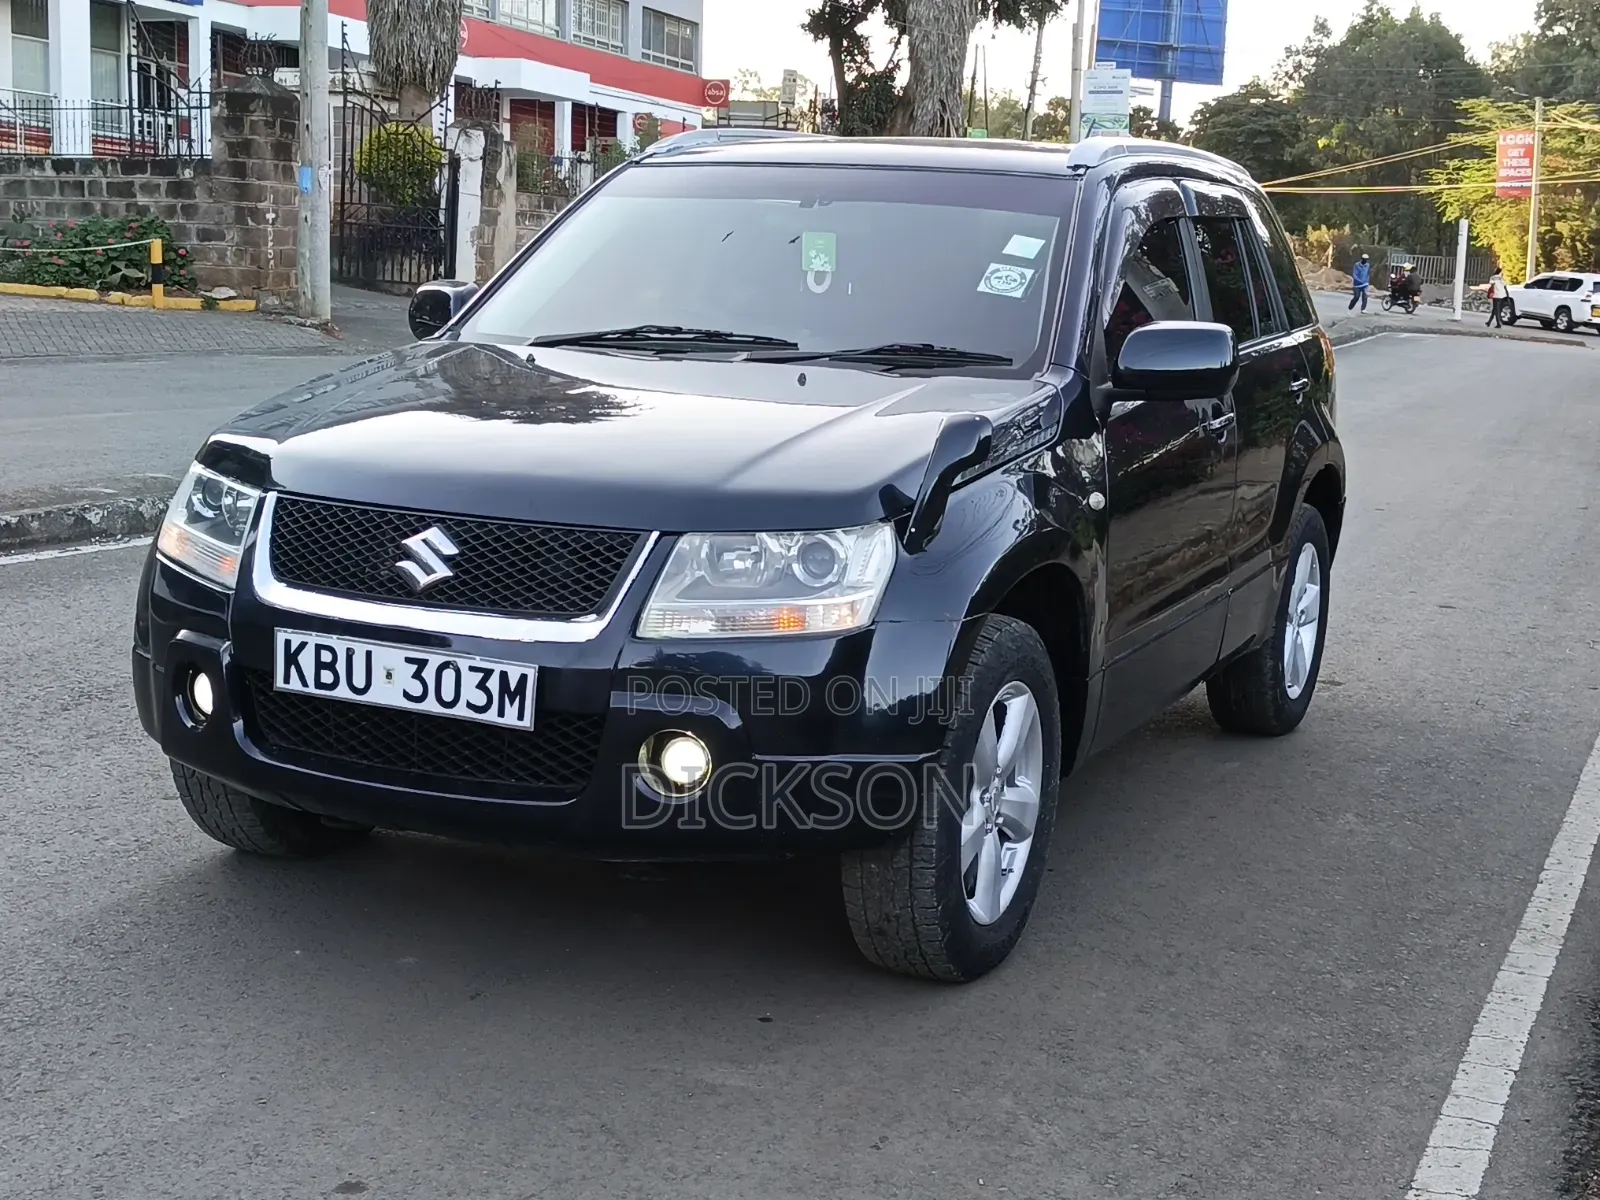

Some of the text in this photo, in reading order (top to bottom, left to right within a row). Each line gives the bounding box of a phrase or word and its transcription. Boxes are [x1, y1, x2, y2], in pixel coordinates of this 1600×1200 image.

[1499, 133, 1534, 145] LOOK
[1502, 158, 1530, 167] THESE
[1498, 168, 1532, 177] SPACES
[282, 638, 528, 722] KBU 303M
